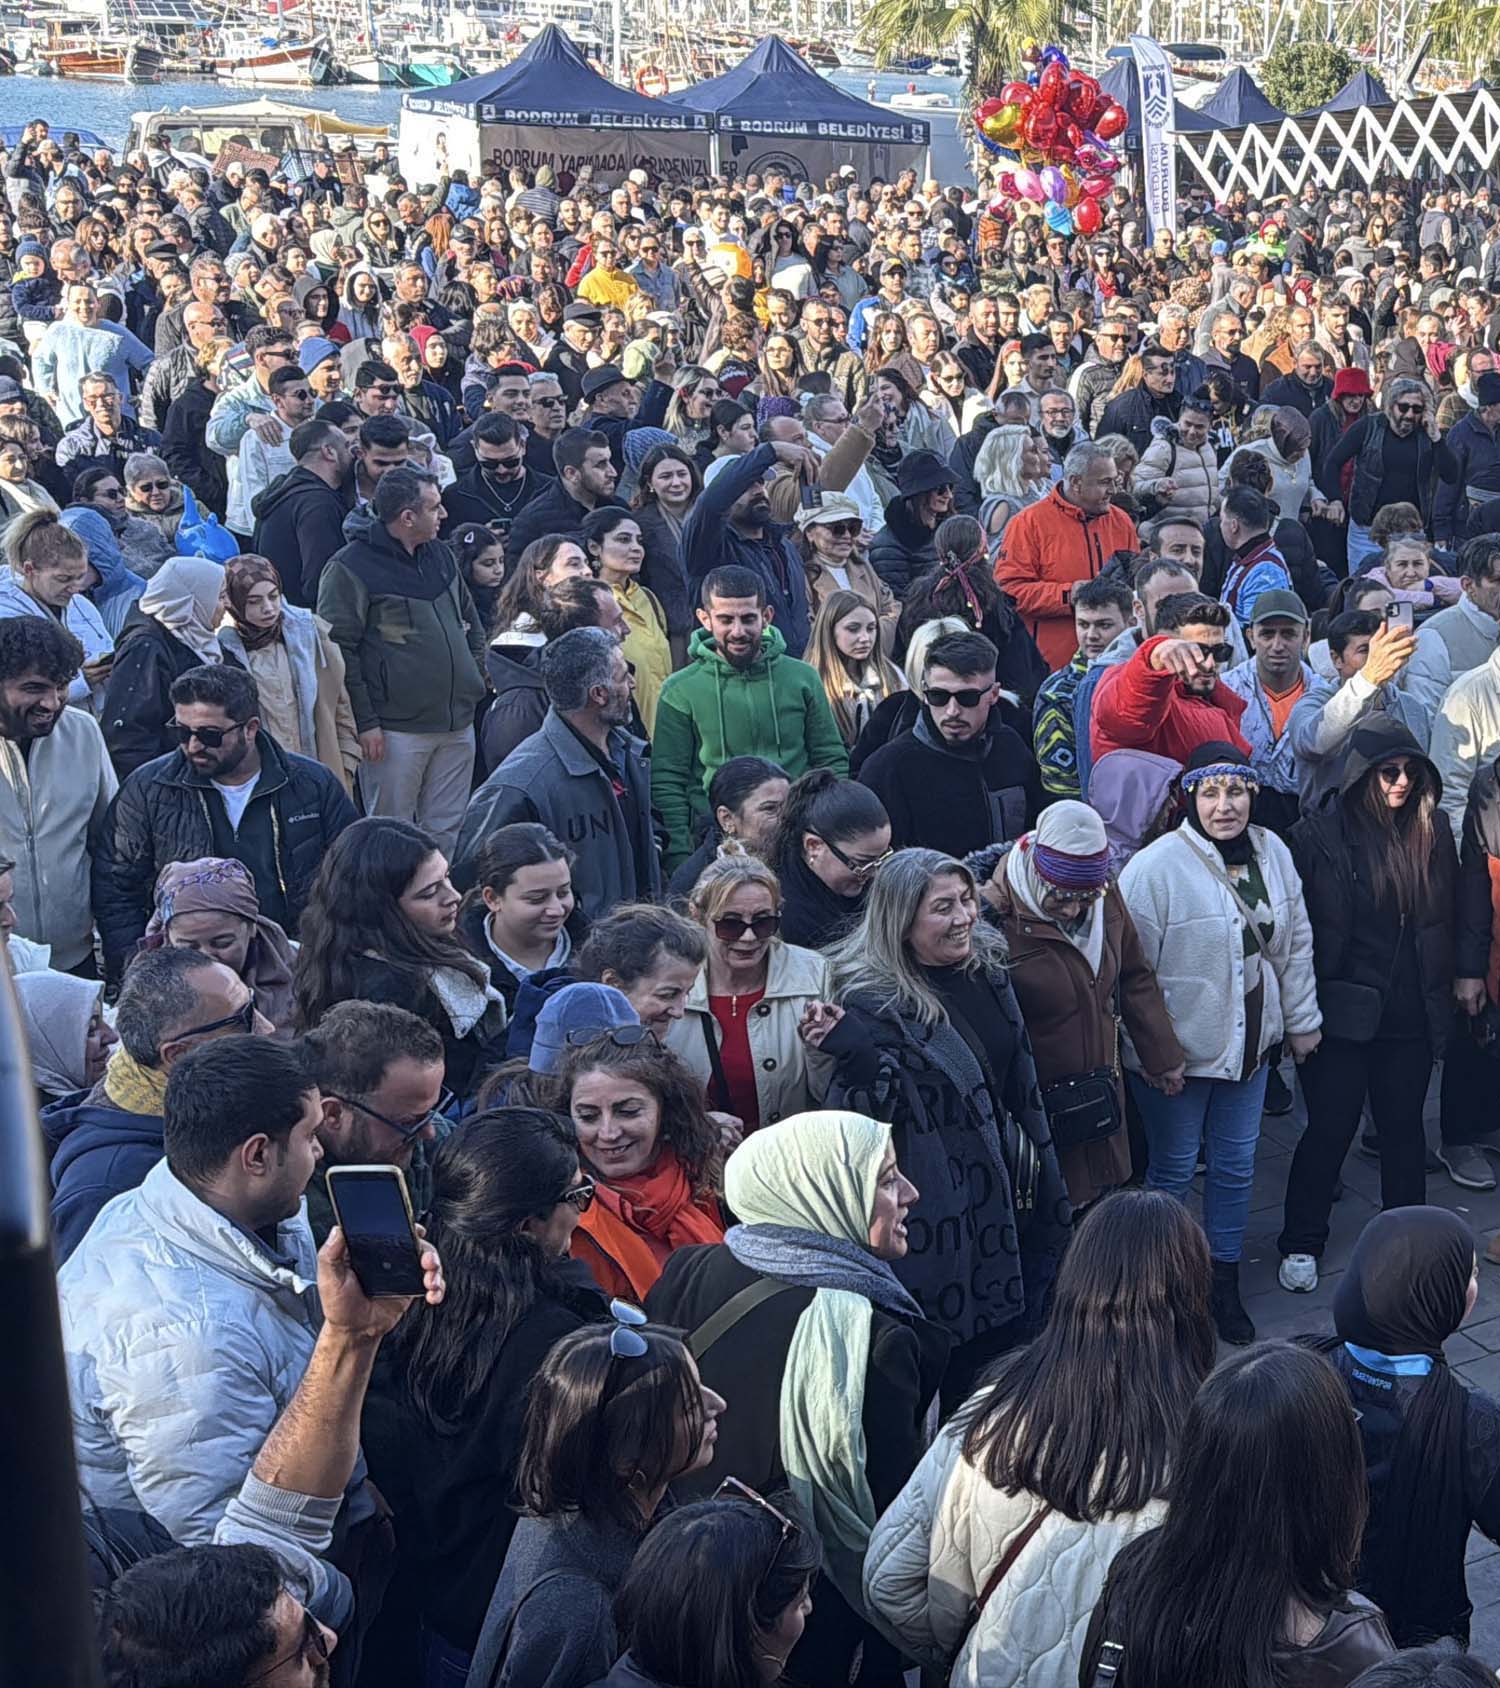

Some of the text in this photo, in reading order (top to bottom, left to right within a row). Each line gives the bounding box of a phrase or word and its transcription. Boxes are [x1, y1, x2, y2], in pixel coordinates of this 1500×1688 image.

[504, 109, 687, 129] BODRUM BELEDİYESİ
[740, 120, 905, 140] BODRUM BELEDİYESİ
[493, 148, 555, 169] BODRUM
